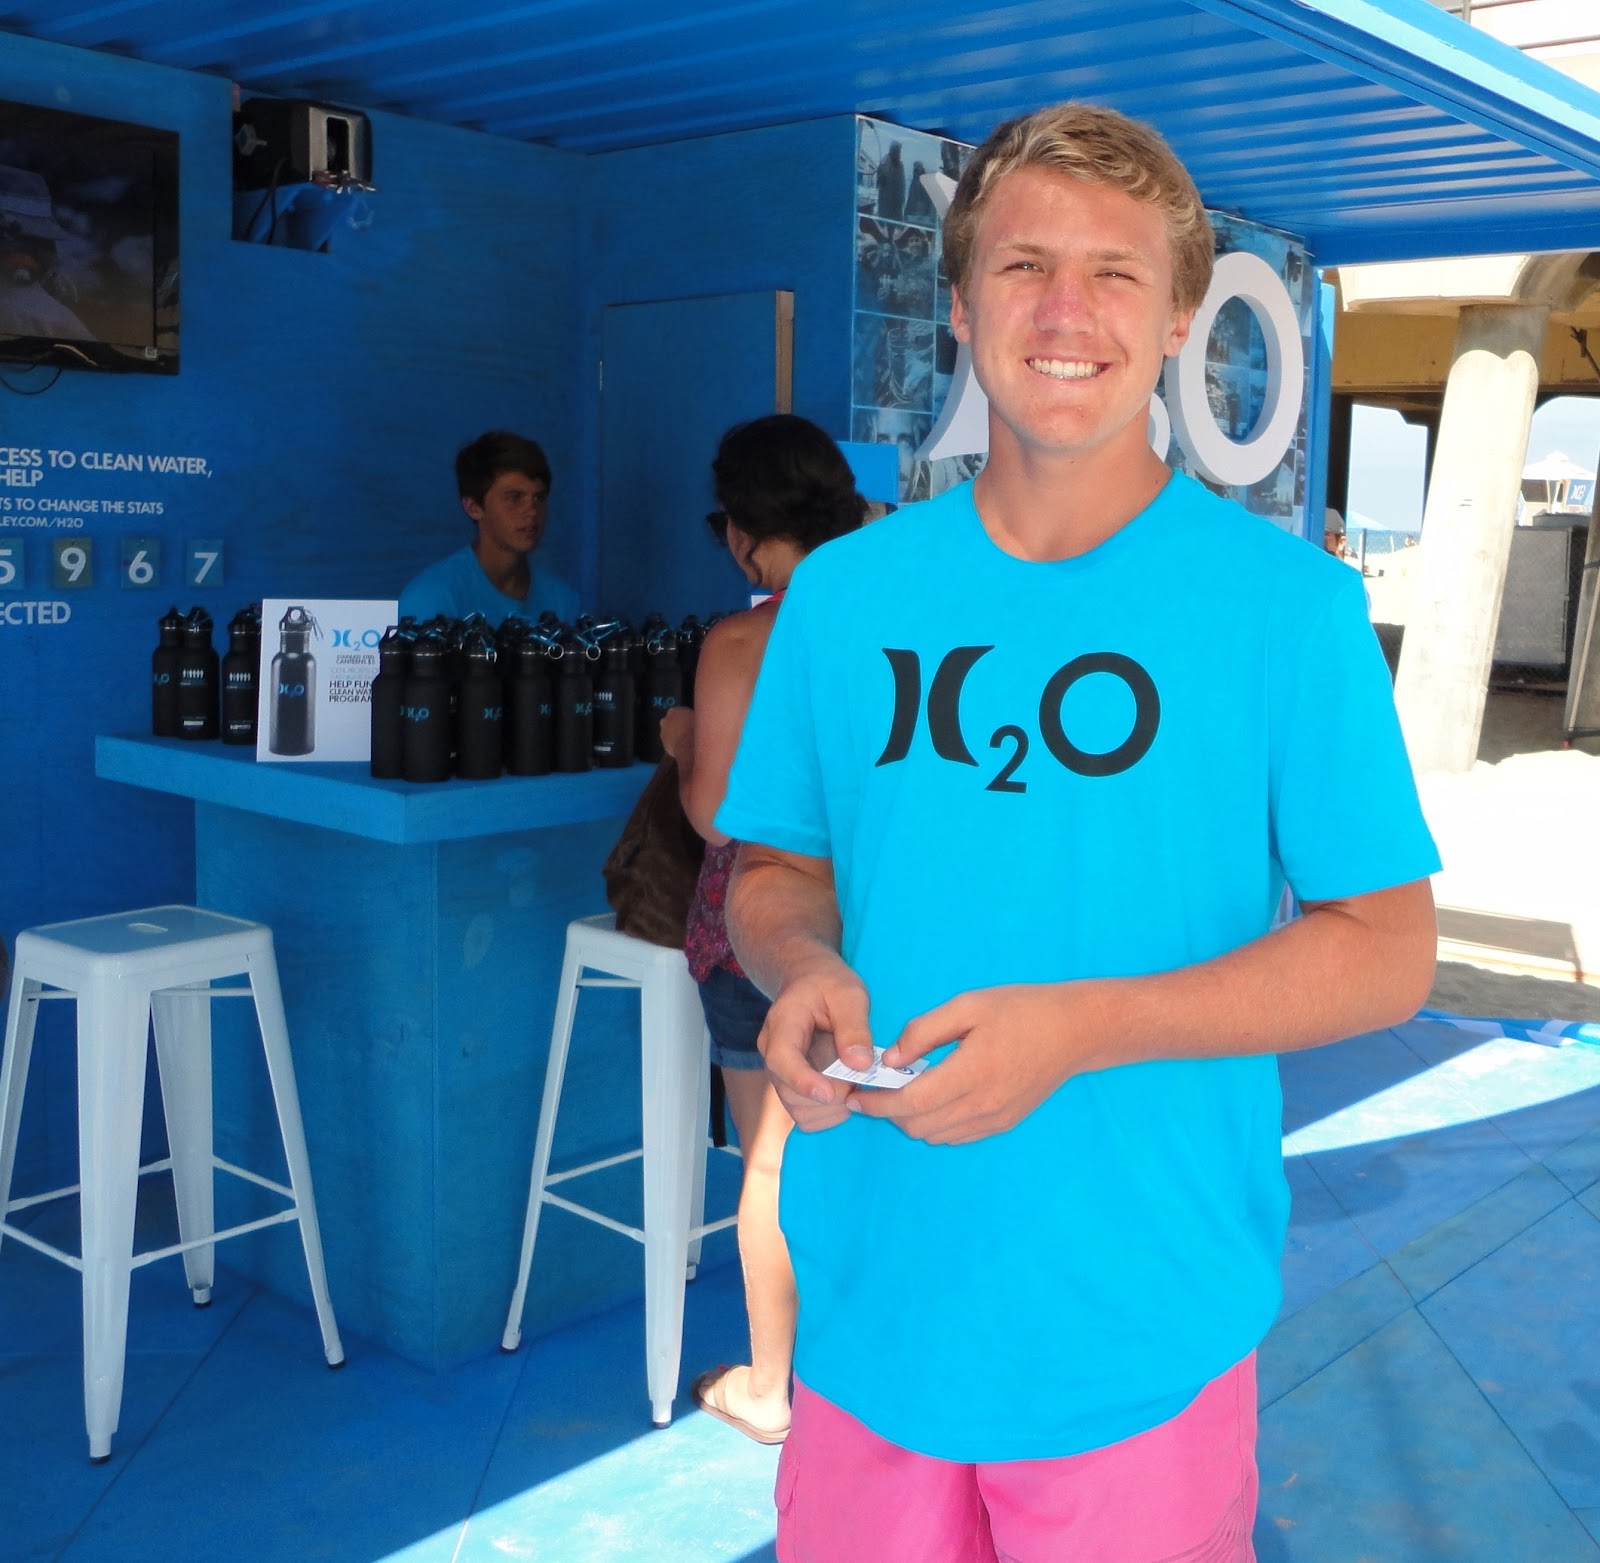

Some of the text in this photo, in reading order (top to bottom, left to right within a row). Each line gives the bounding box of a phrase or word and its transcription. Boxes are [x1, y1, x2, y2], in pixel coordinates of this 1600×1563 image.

[48, 449, 77, 469] TO
[81, 451, 144, 472] CLEAN
[147, 455, 214, 478] WATER,
[0, 469, 44, 487] HELP
[15, 498, 35, 511] TO
[38, 498, 99, 513] CHANGE
[101, 500, 125, 514] THE
[127, 501, 164, 515] STATS
[60, 547, 87, 582] 9
[128, 550, 154, 584] 6
[194, 552, 219, 584] 7
[329, 680, 353, 688] HELP
